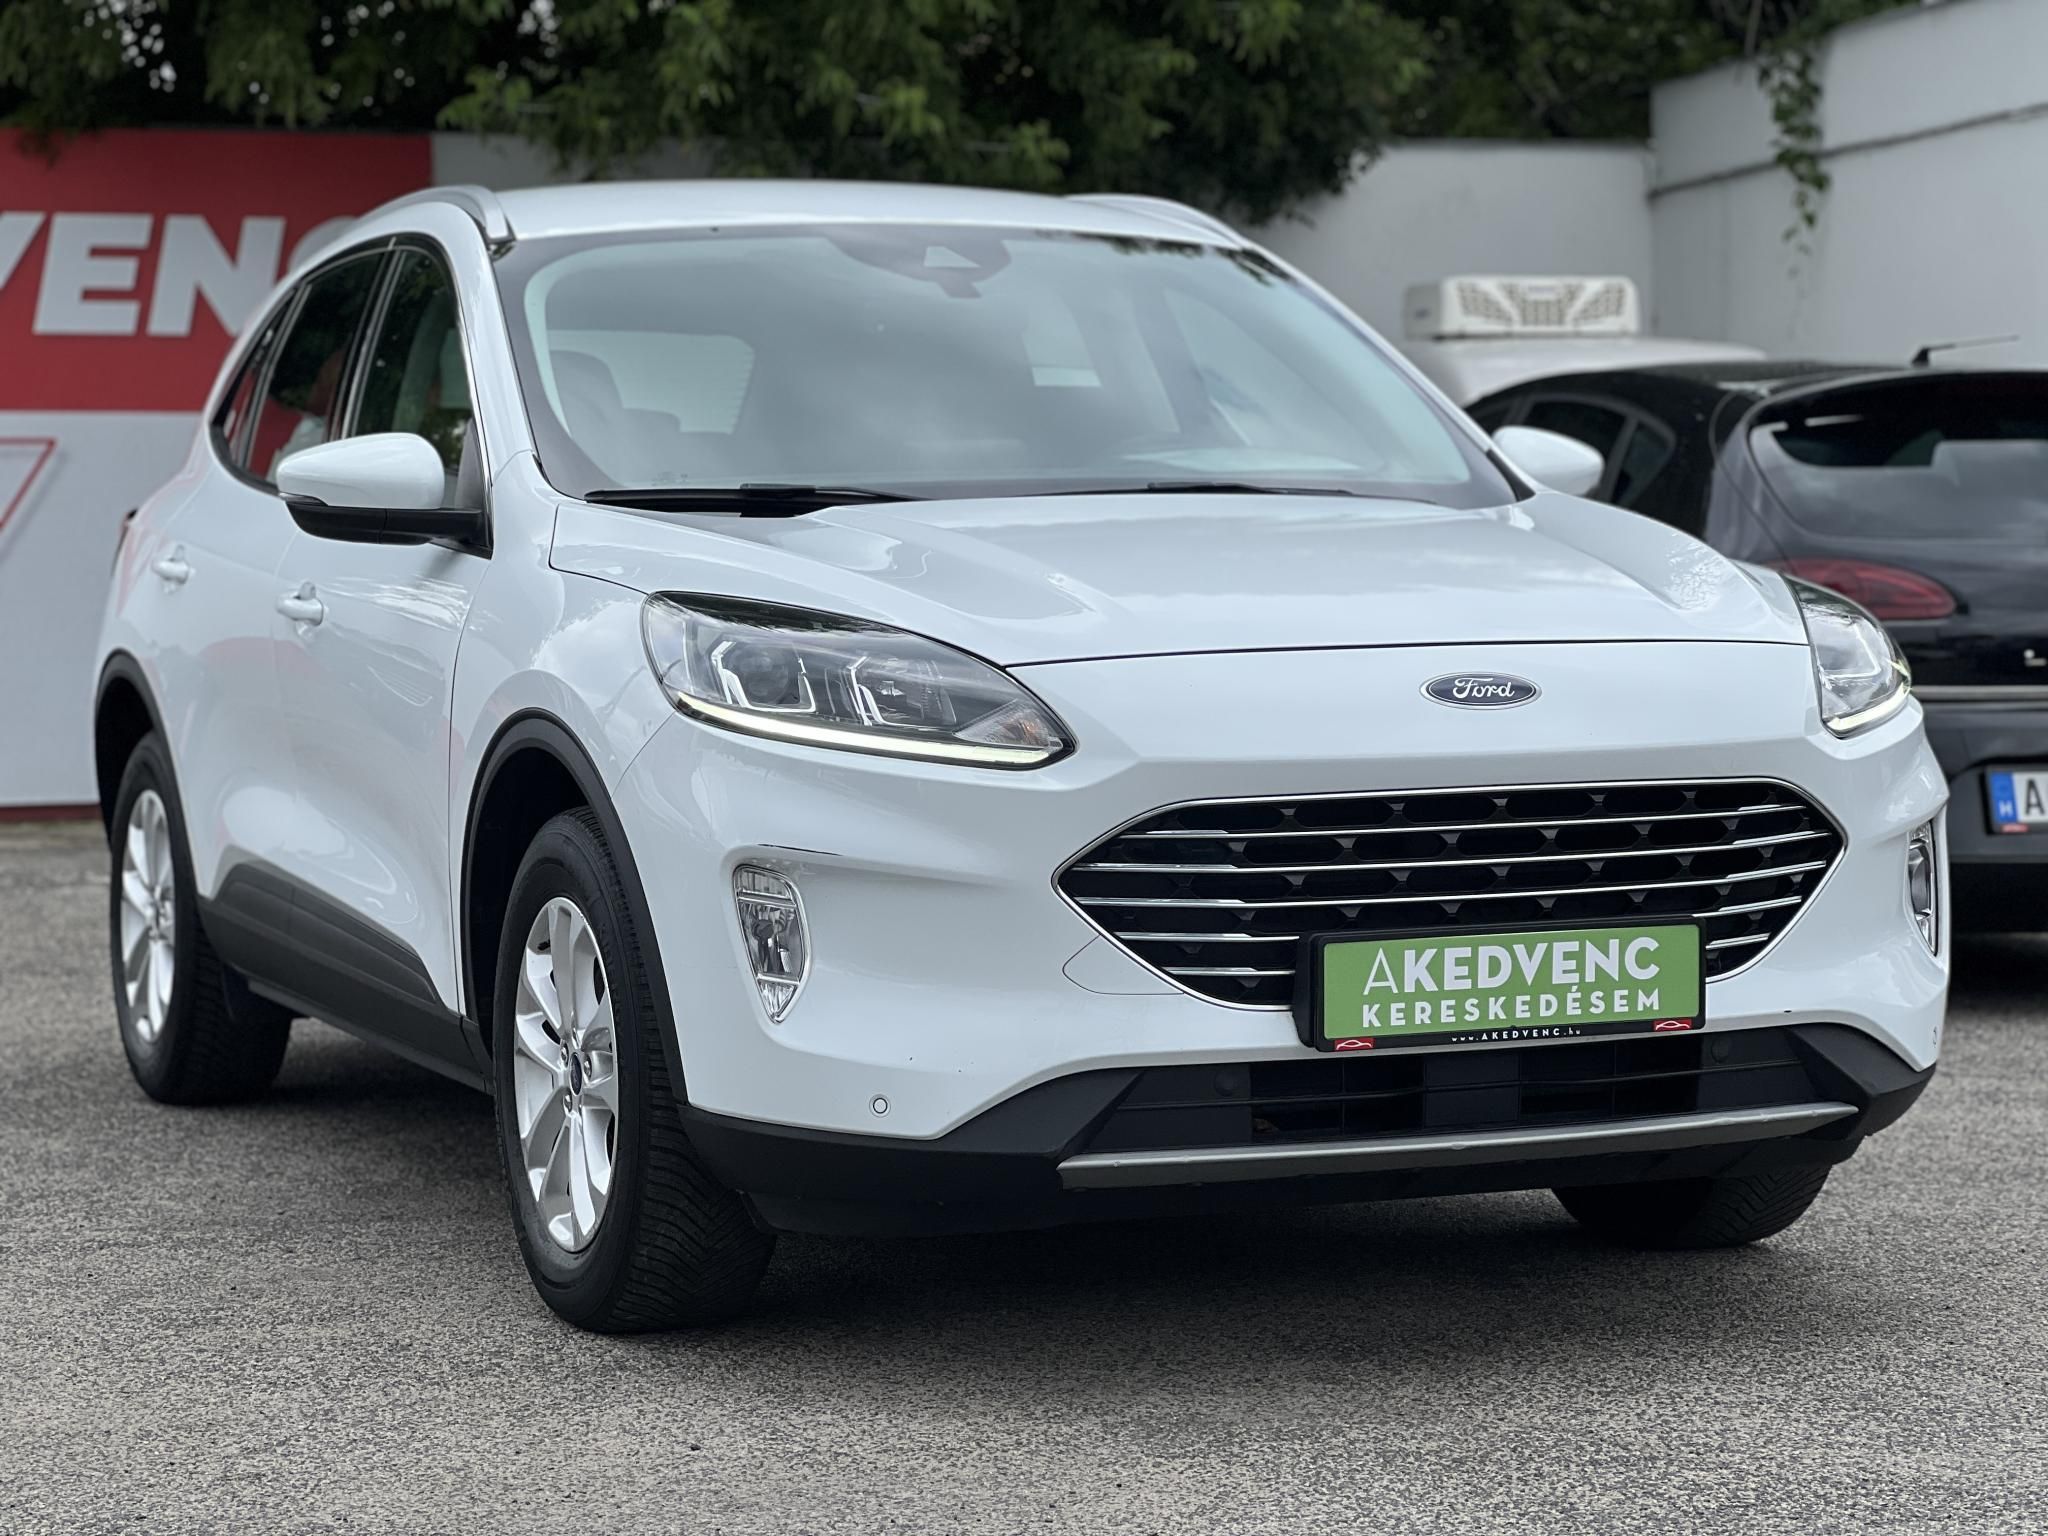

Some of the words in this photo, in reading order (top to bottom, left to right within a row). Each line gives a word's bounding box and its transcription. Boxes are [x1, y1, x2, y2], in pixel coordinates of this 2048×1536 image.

[0, 211, 360, 337] EN
[1452, 677, 1515, 699] Ford
[1362, 985, 1660, 1027] KERESKEDÉSEM
